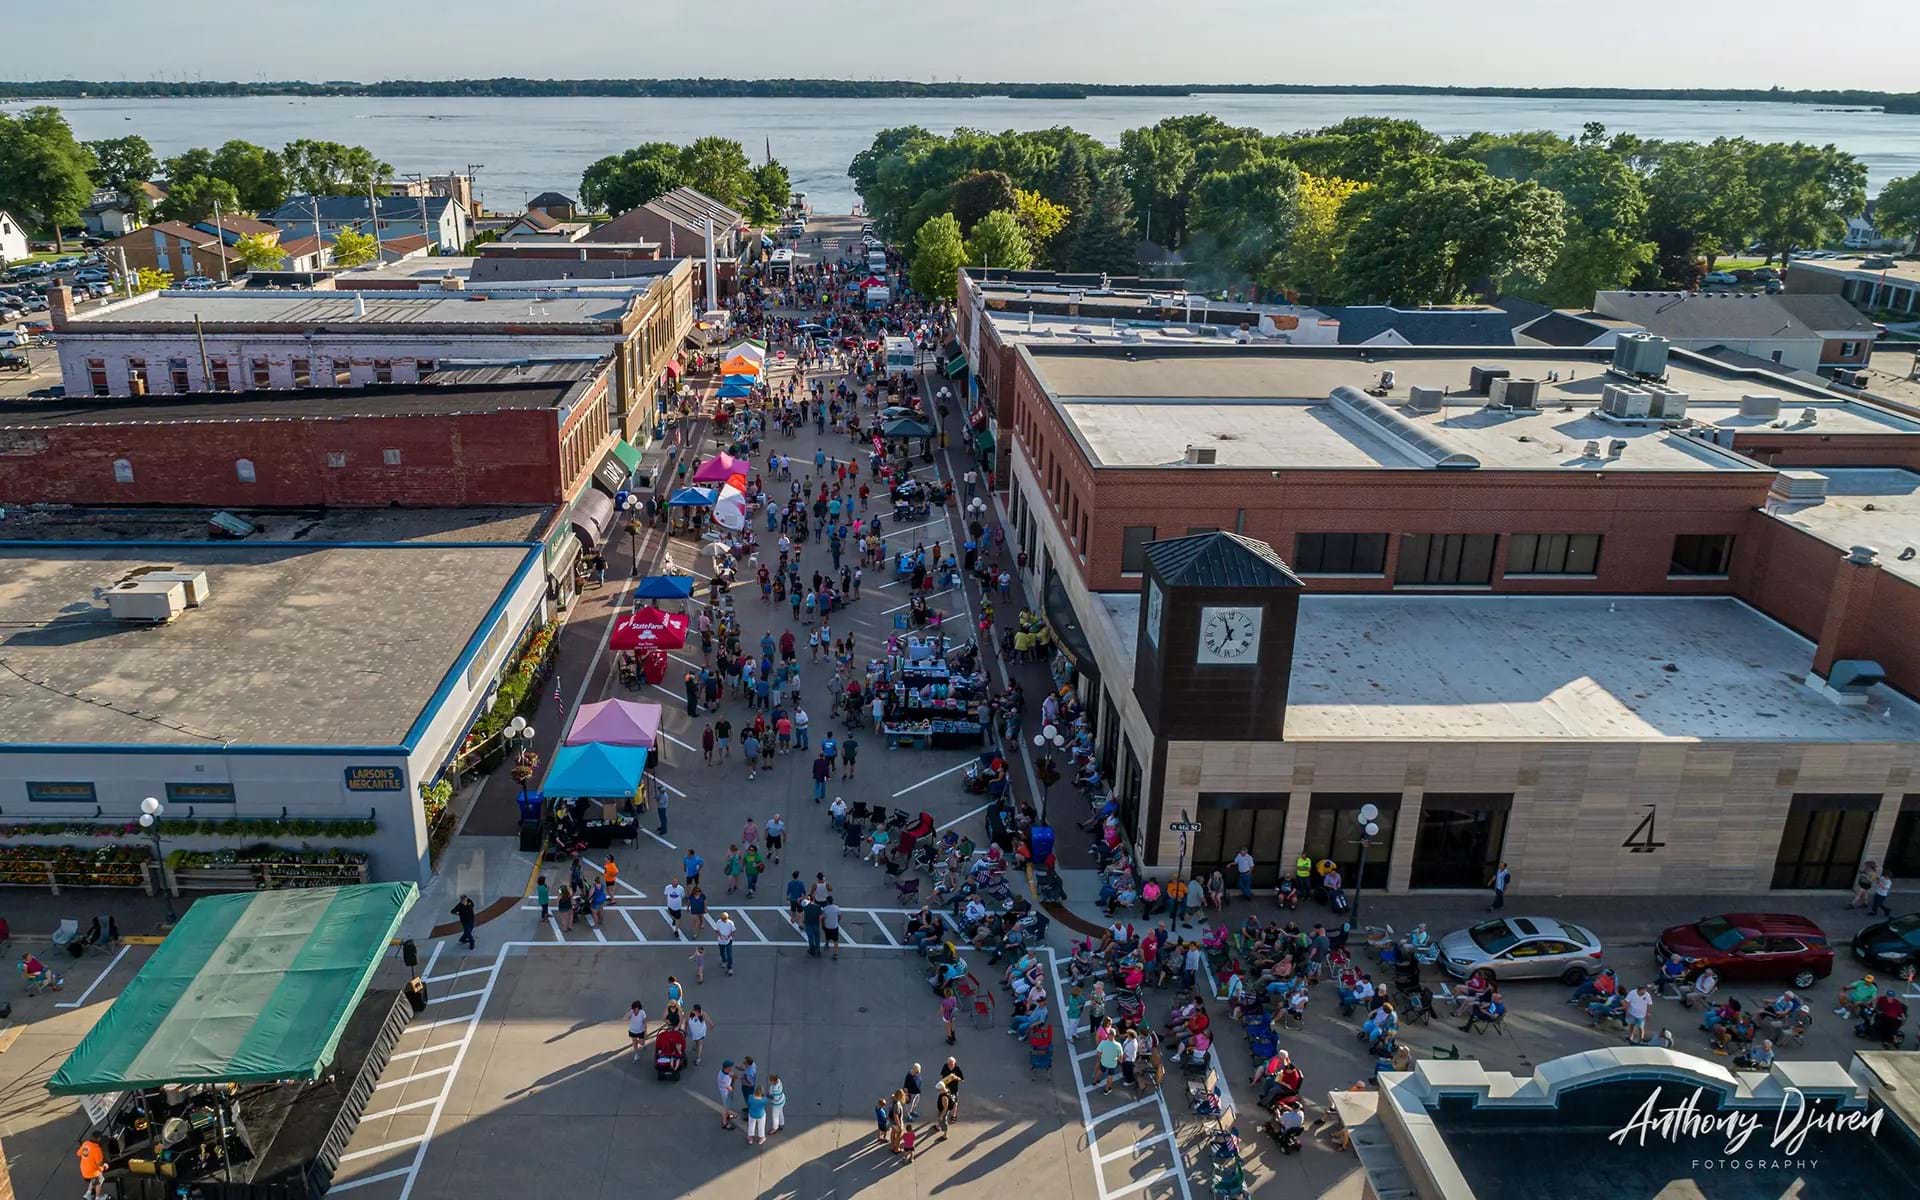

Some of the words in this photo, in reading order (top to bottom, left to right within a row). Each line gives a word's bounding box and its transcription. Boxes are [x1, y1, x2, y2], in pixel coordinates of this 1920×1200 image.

[352, 769, 394, 778] LARSON'S
[349, 779, 401, 789] MERCANTILE
[1621, 804, 1666, 853] 4
